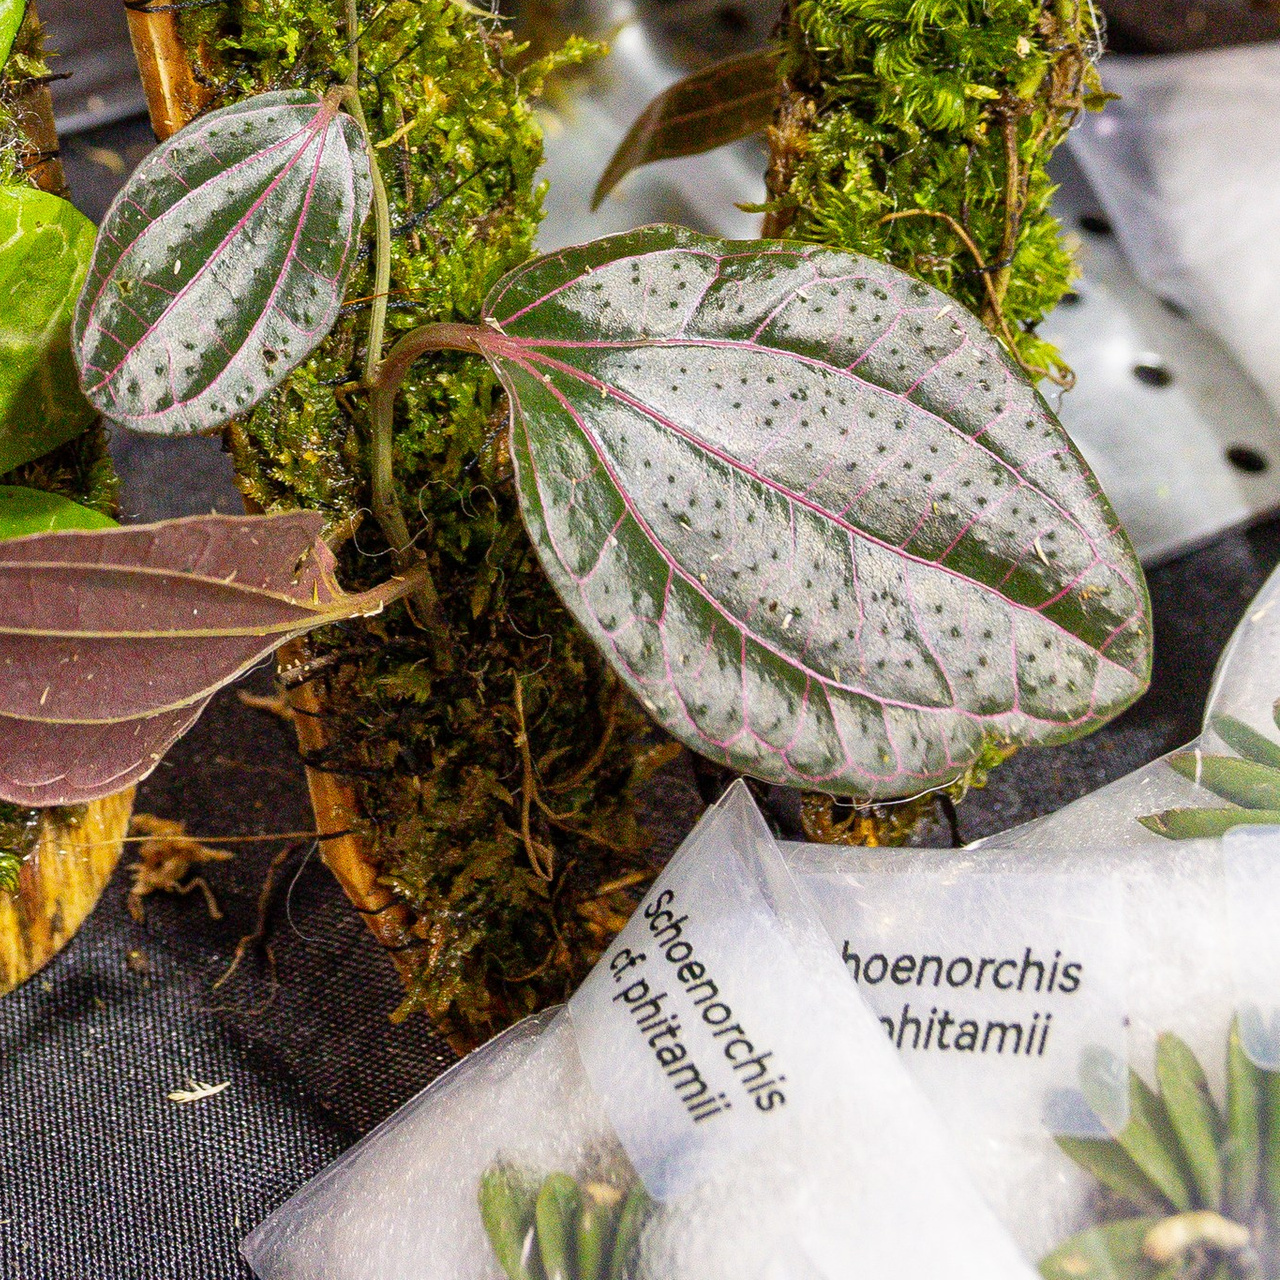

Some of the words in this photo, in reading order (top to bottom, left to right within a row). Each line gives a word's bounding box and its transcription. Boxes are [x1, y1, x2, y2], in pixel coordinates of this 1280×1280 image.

[609, 947, 647, 983] cf.
[643, 889, 787, 1112] Schoenorchis
[612, 976, 732, 1123] phitamii
